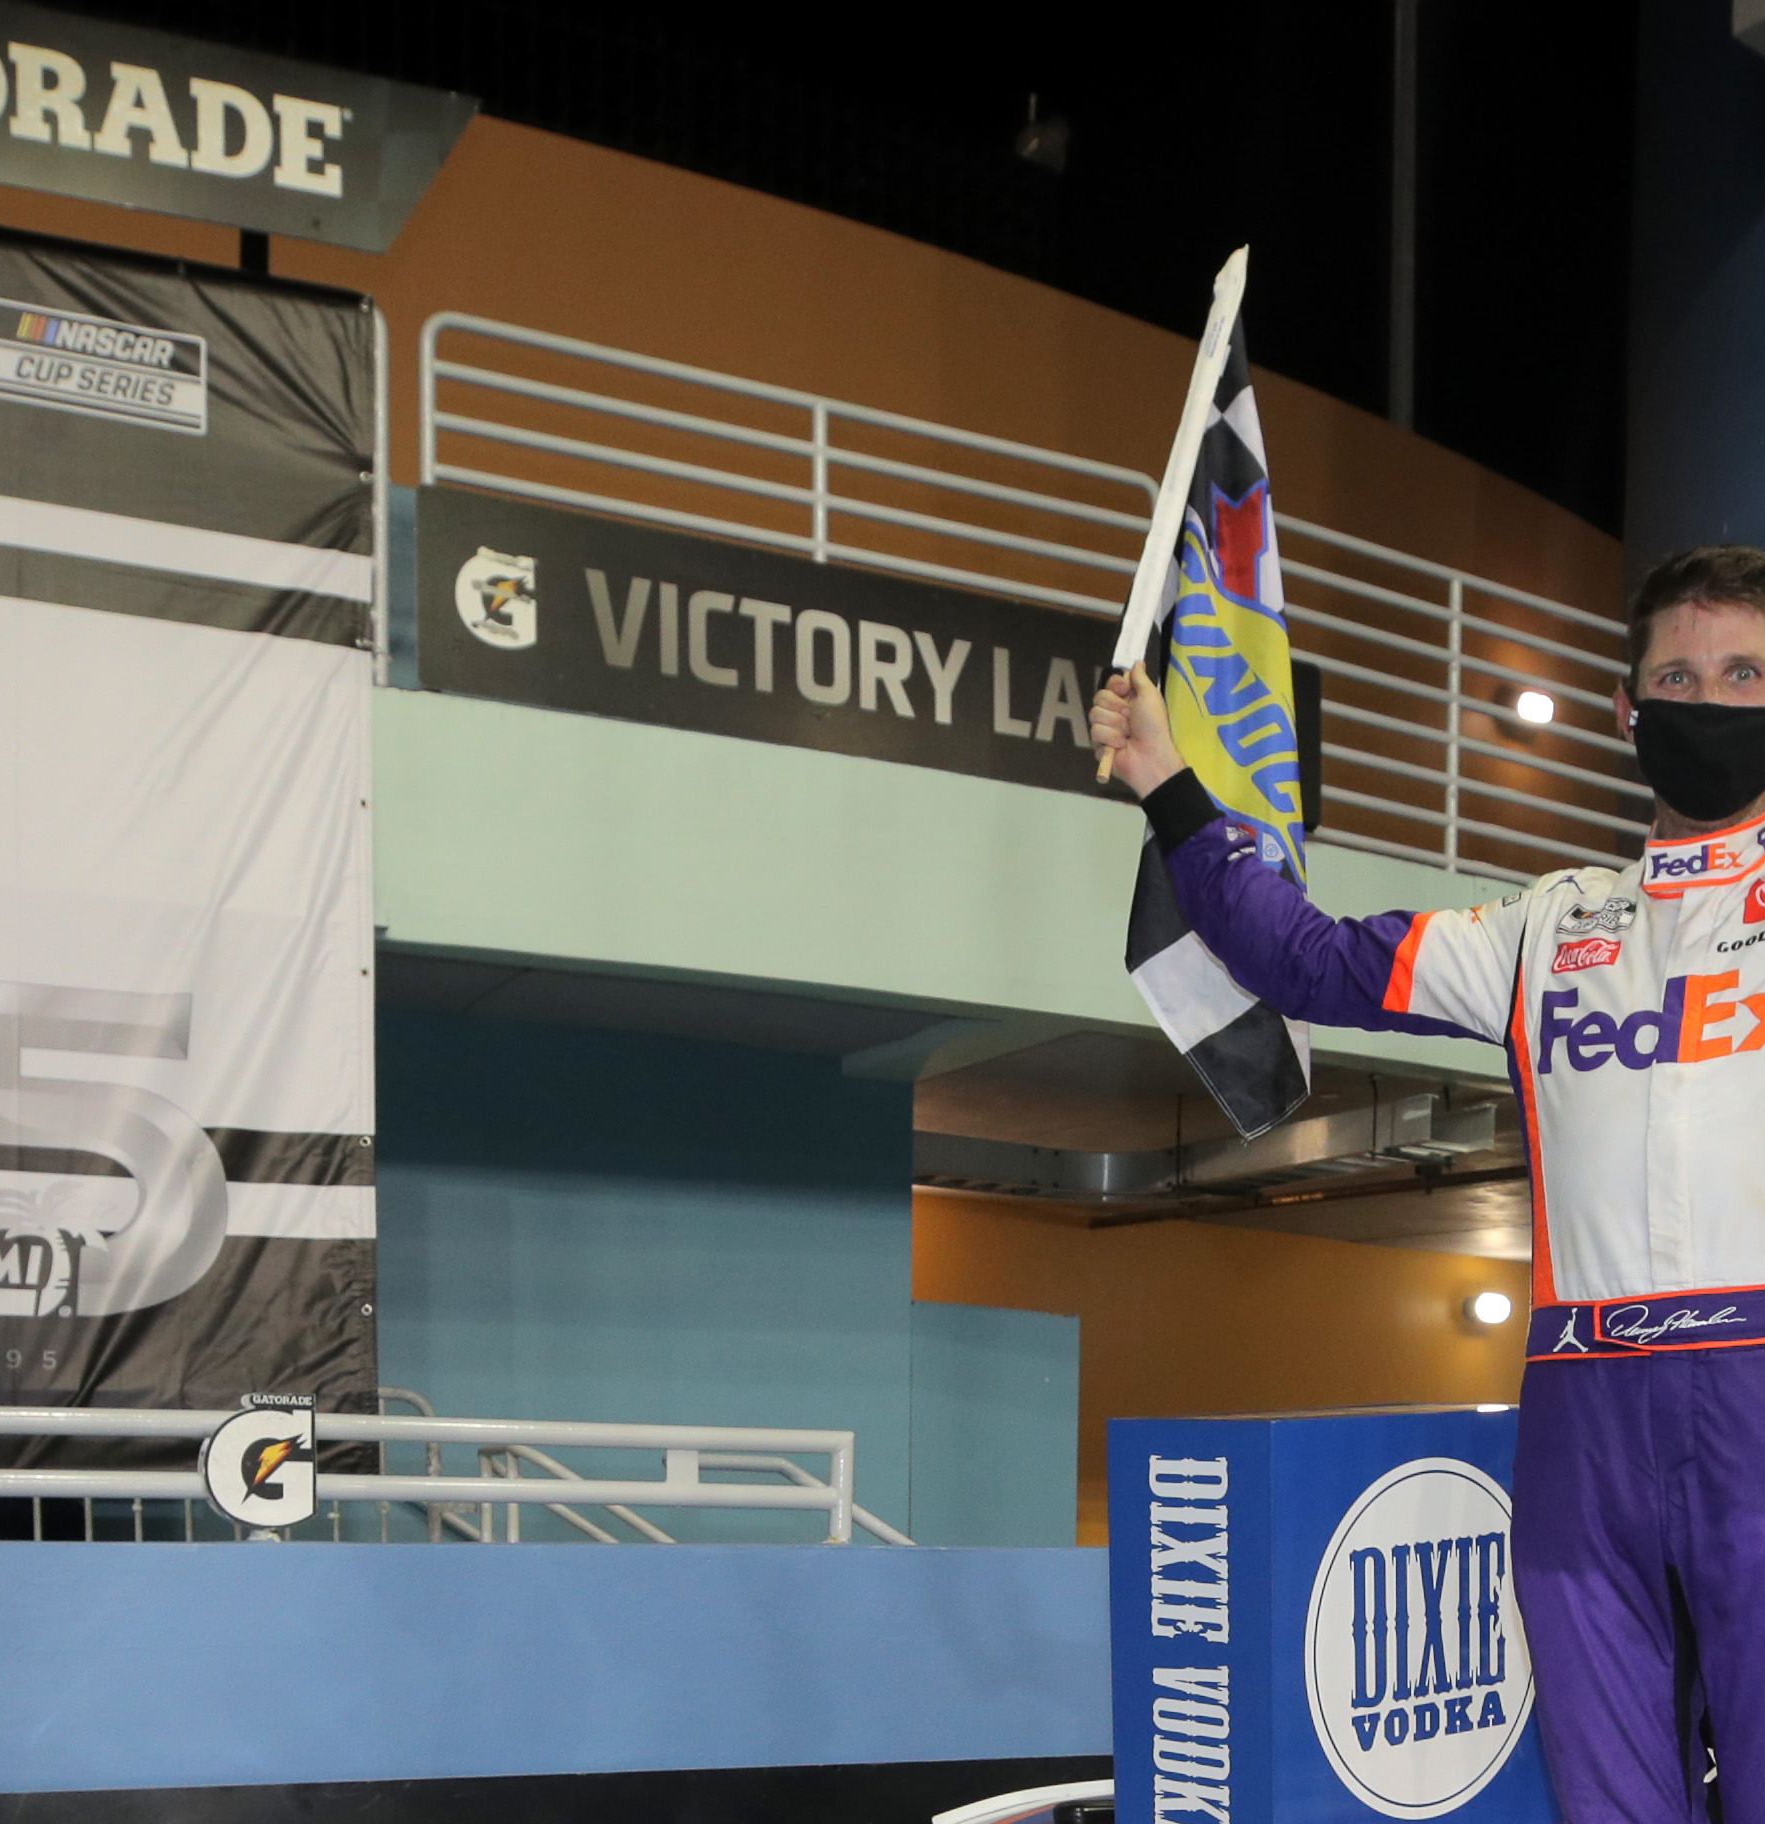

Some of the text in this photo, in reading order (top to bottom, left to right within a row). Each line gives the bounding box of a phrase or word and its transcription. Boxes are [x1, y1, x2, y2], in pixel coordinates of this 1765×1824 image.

[53, 316, 174, 367] NASCAR
[15, 354, 175, 407] CUP SERIES
[584, 567, 1108, 750] VICTORY LA
[1651, 842, 1744, 880] FedEx
[253, 1395, 312, 1405] GATORADE
[1148, 1453, 1229, 1645] DIXIE
[1350, 1532, 1508, 1708] DIXIE
[1350, 1696, 1508, 1752] VODKA
